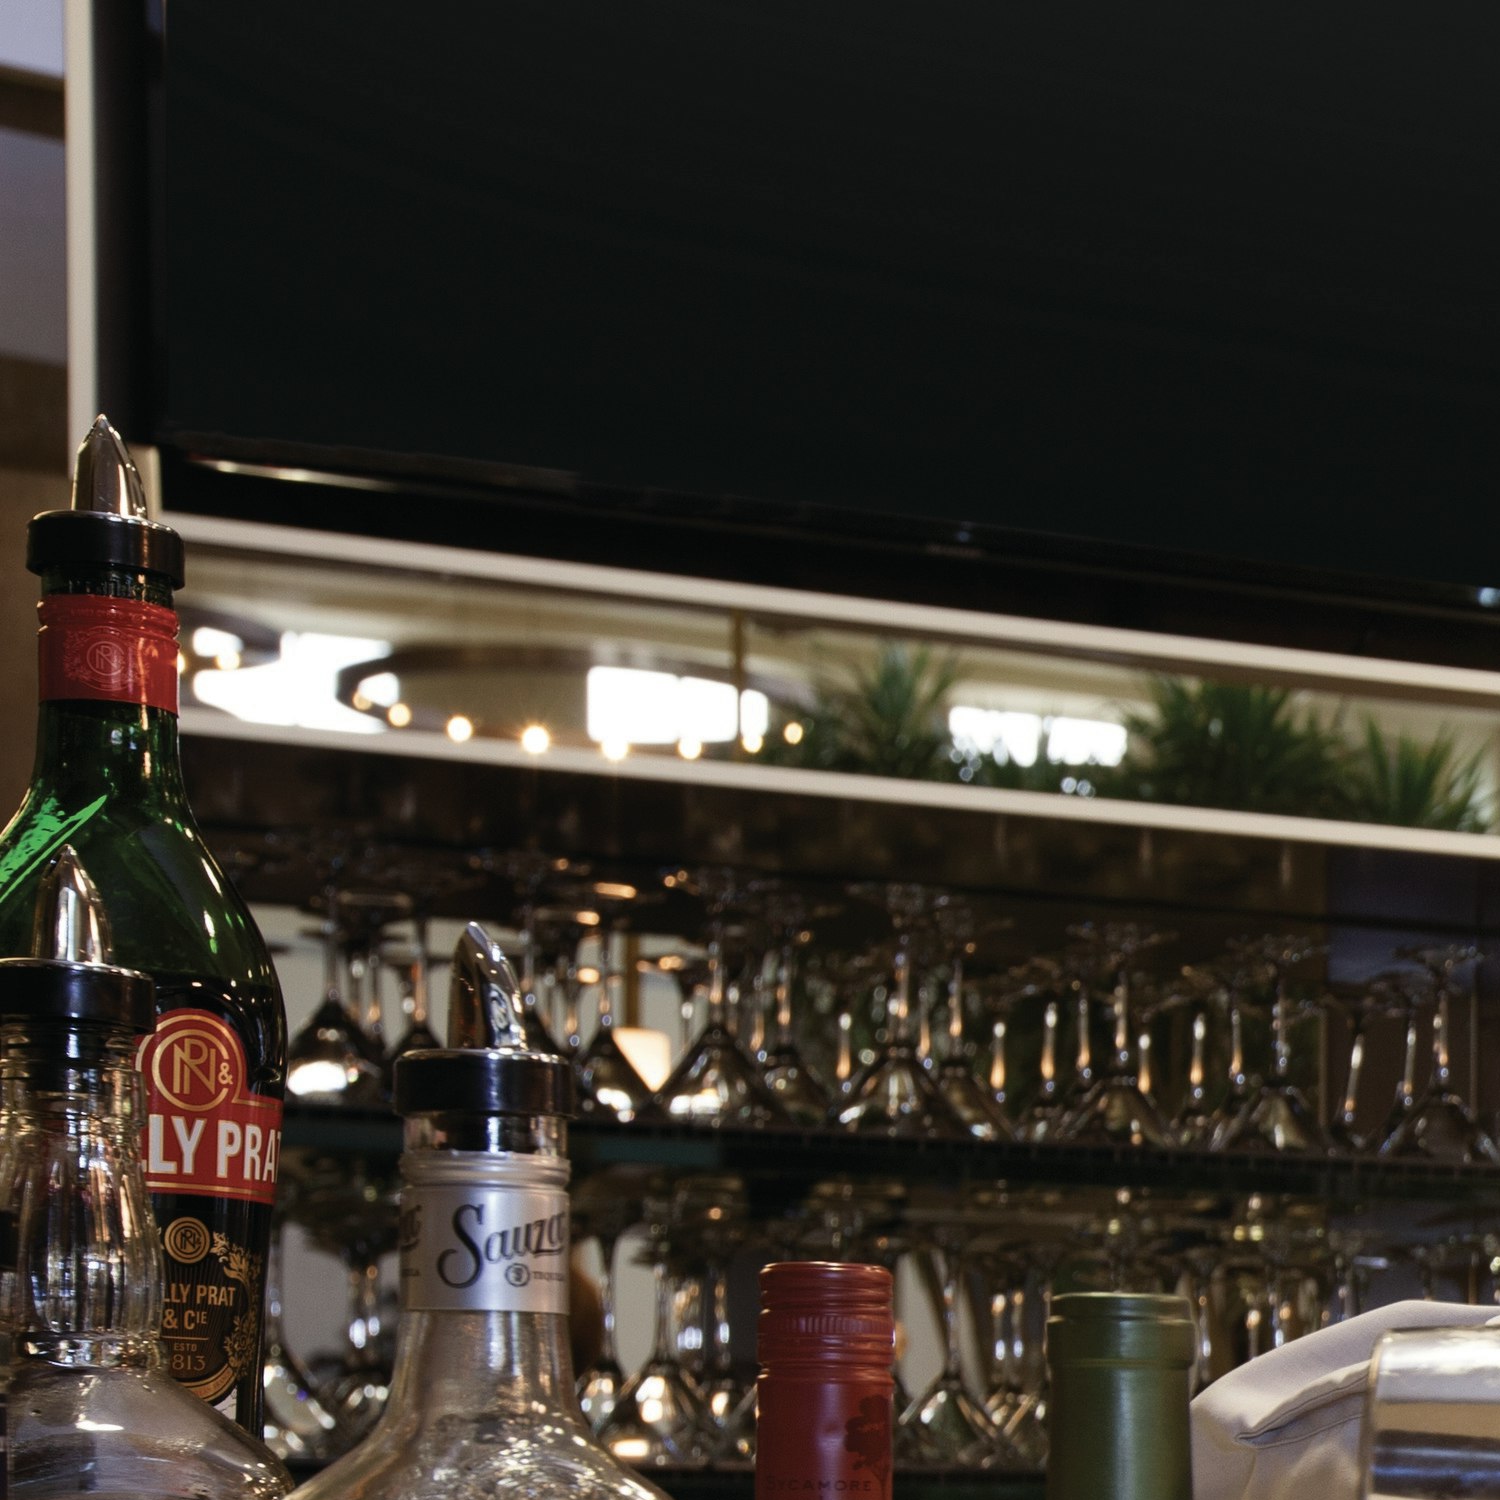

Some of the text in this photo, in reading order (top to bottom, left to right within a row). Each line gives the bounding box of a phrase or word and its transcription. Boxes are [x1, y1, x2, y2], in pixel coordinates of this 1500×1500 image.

[142, 1114, 282, 1184] LY PRA
[163, 1283, 235, 1307] LY PRAT
[163, 1308, 178, 1329] &
